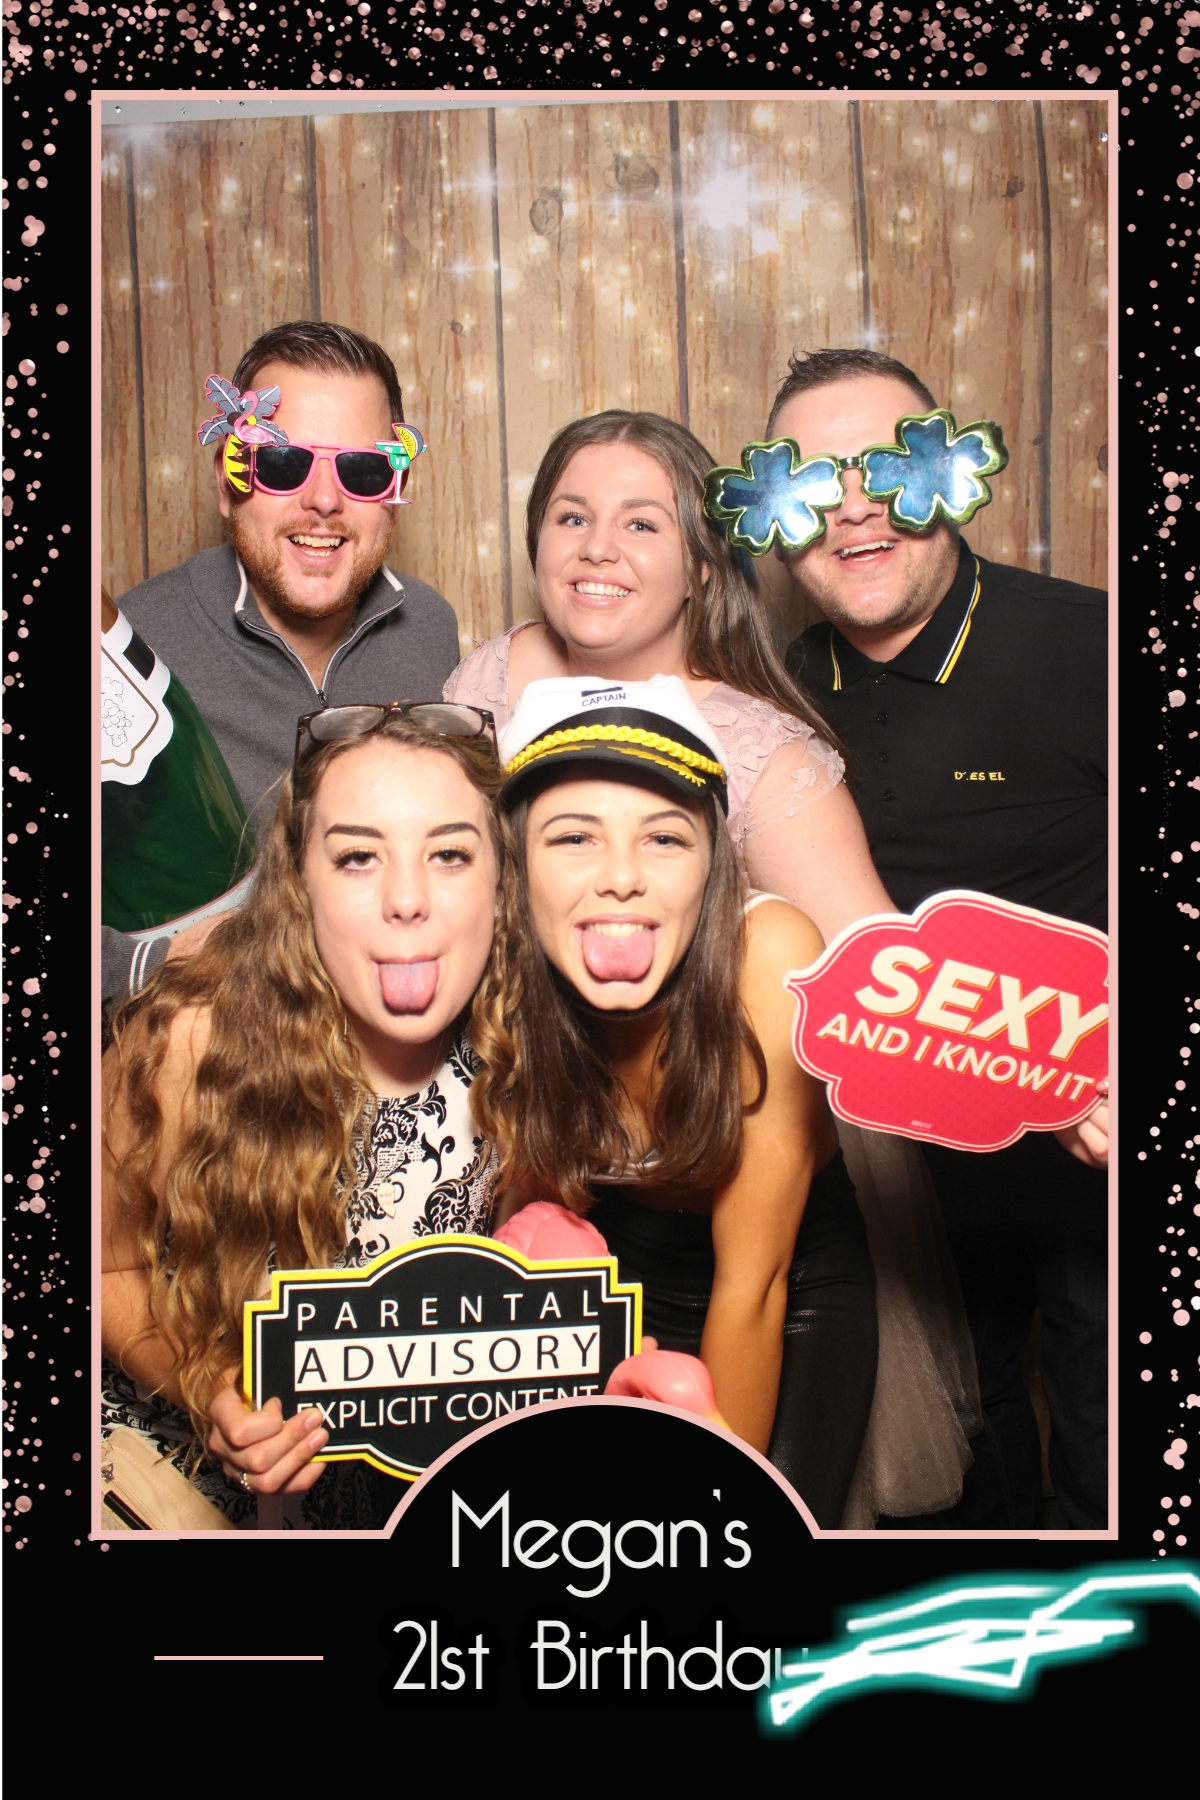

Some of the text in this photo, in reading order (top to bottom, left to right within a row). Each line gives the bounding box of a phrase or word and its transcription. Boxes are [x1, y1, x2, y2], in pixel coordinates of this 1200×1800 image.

[581, 692, 627, 708] CAPTAIN
[854, 945, 1109, 1062] SEXY
[816, 1012, 1095, 1102] AND I KNOW IT
[296, 1289, 600, 1332] PARENTAL
[297, 1332, 598, 1385] ADVISORY
